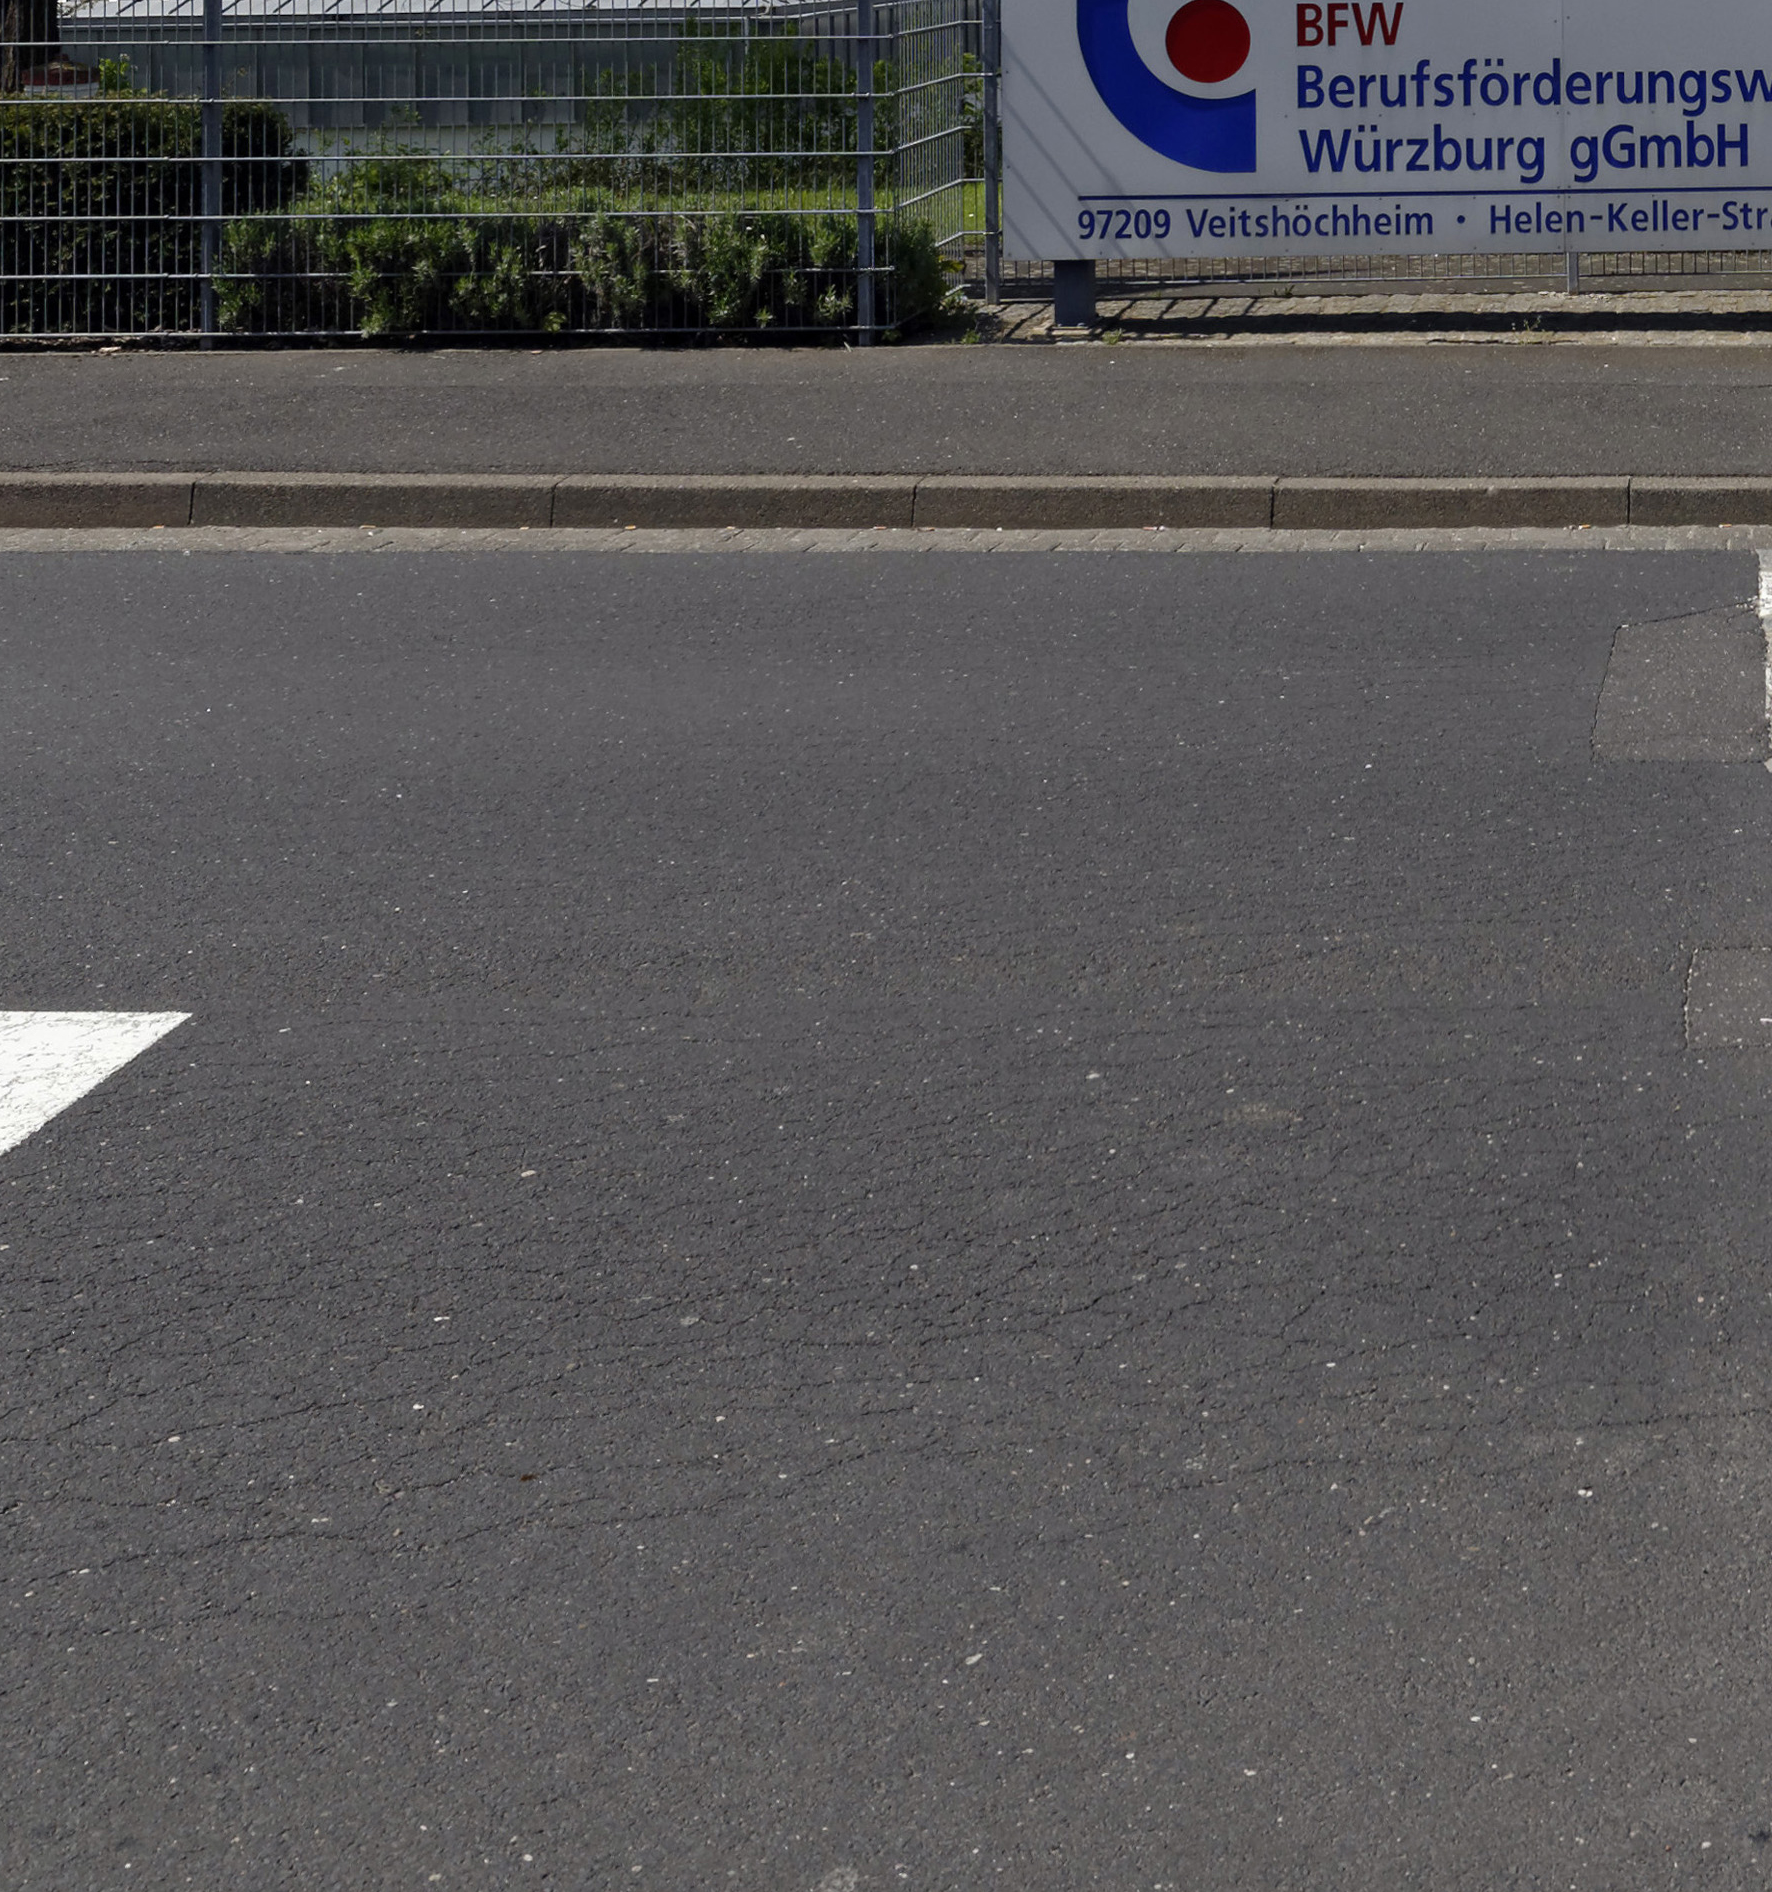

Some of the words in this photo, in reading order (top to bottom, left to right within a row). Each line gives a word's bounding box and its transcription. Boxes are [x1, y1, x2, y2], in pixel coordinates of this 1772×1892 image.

[1296, 2, 1405, 47] BFW
[1298, 125, 1546, 185] Würzburg
[1569, 119, 1750, 184] gGmbH
[1077, 207, 1173, 241] 97209
[1185, 202, 1435, 240] Veitshöchheim
